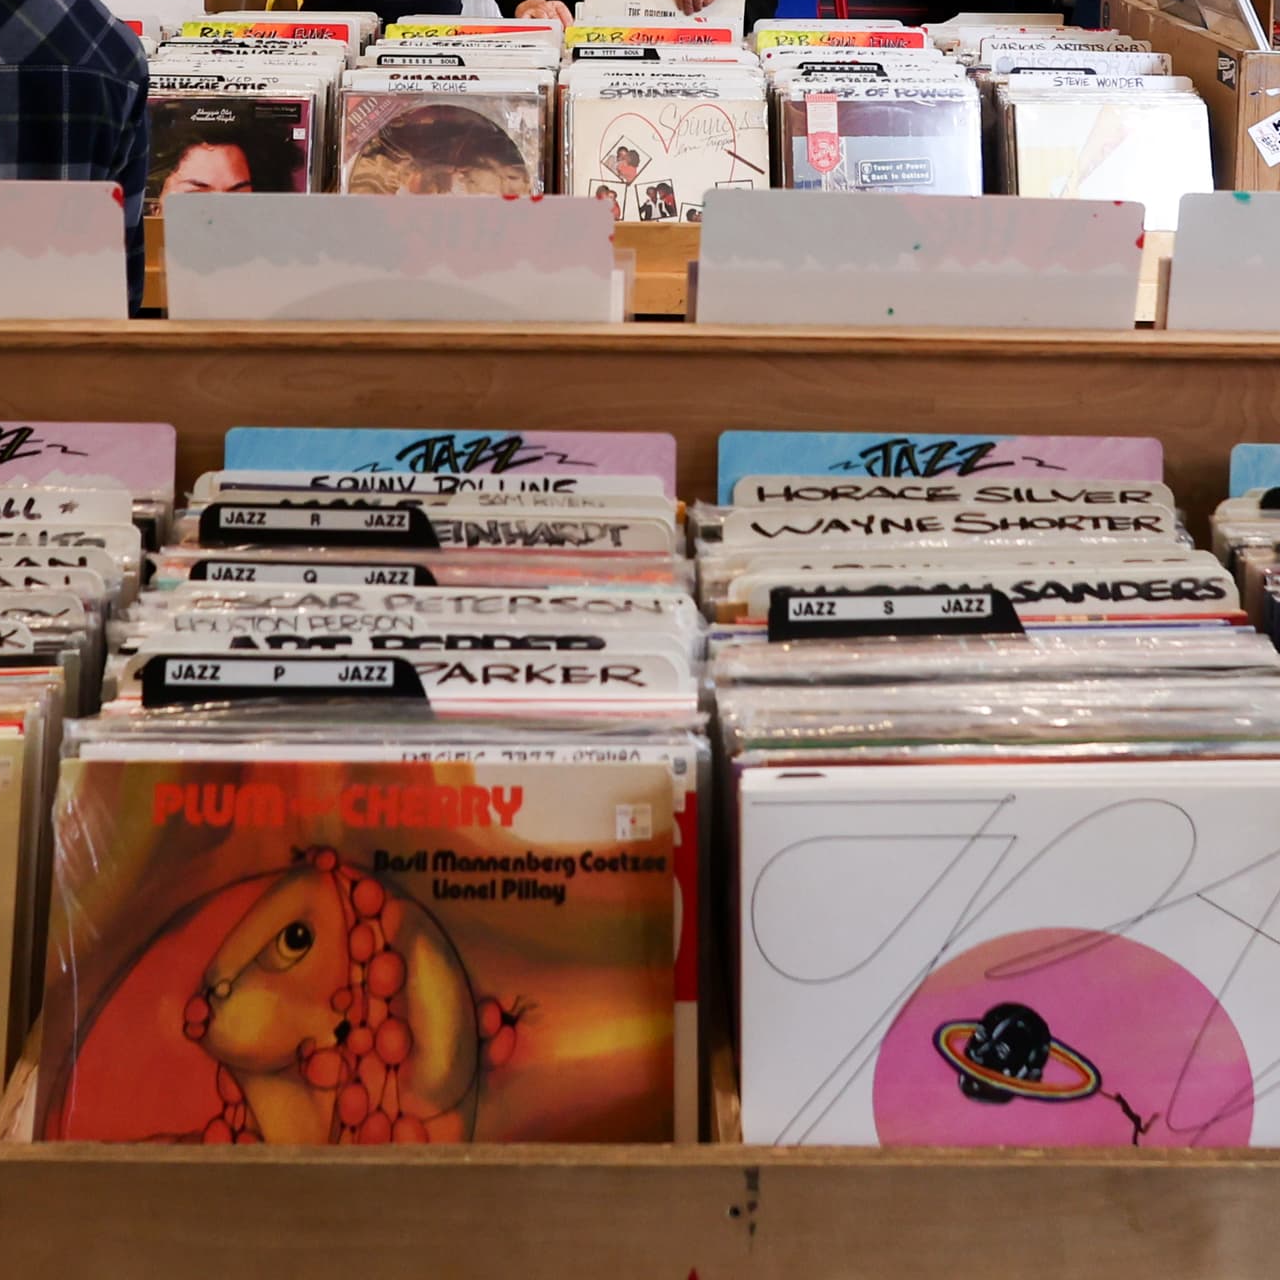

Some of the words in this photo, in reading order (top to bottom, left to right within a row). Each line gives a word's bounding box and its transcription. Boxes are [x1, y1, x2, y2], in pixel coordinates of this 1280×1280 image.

[991, 43, 1046, 51] VARIOUS
[1053, 43, 1105, 51] ARTISTS
[432, 82, 467, 92] RICHIE
[1053, 77, 1090, 87] STEVIE
[1096, 77, 1144, 88] WONDER
[396, 435, 548, 474] JAZZ
[860, 438, 1013, 477] JAZZ
[757, 485, 961, 503] HORACE
[971, 486, 1151, 504] SILVER
[225, 511, 266, 526] JAZZ
[310, 513, 320, 526] R
[365, 513, 407, 528] JAZZ
[751, 515, 943, 538] WAYNE
[953, 513, 1161, 533] SHORTER
[212, 567, 255, 583] JAZZ
[303, 569, 317, 584] Q
[364, 568, 408, 585] JAZZ
[1011, 577, 1226, 603] SANDERS
[792, 601, 835, 616] JAZZ
[884, 601, 893, 615] S
[941, 598, 985, 613] JAZZ
[171, 663, 220, 681] JAZZ
[273, 665, 285, 681] P
[338, 664, 387, 682] JAZZ
[416, 661, 647, 687] PARKER
[338, 785, 523, 828] CHERRY
[433, 851, 576, 877] Mannenberg
[580, 851, 666, 871] Coetzee
[433, 880, 495, 899] Lionel
[502, 880, 566, 905] Pillay
